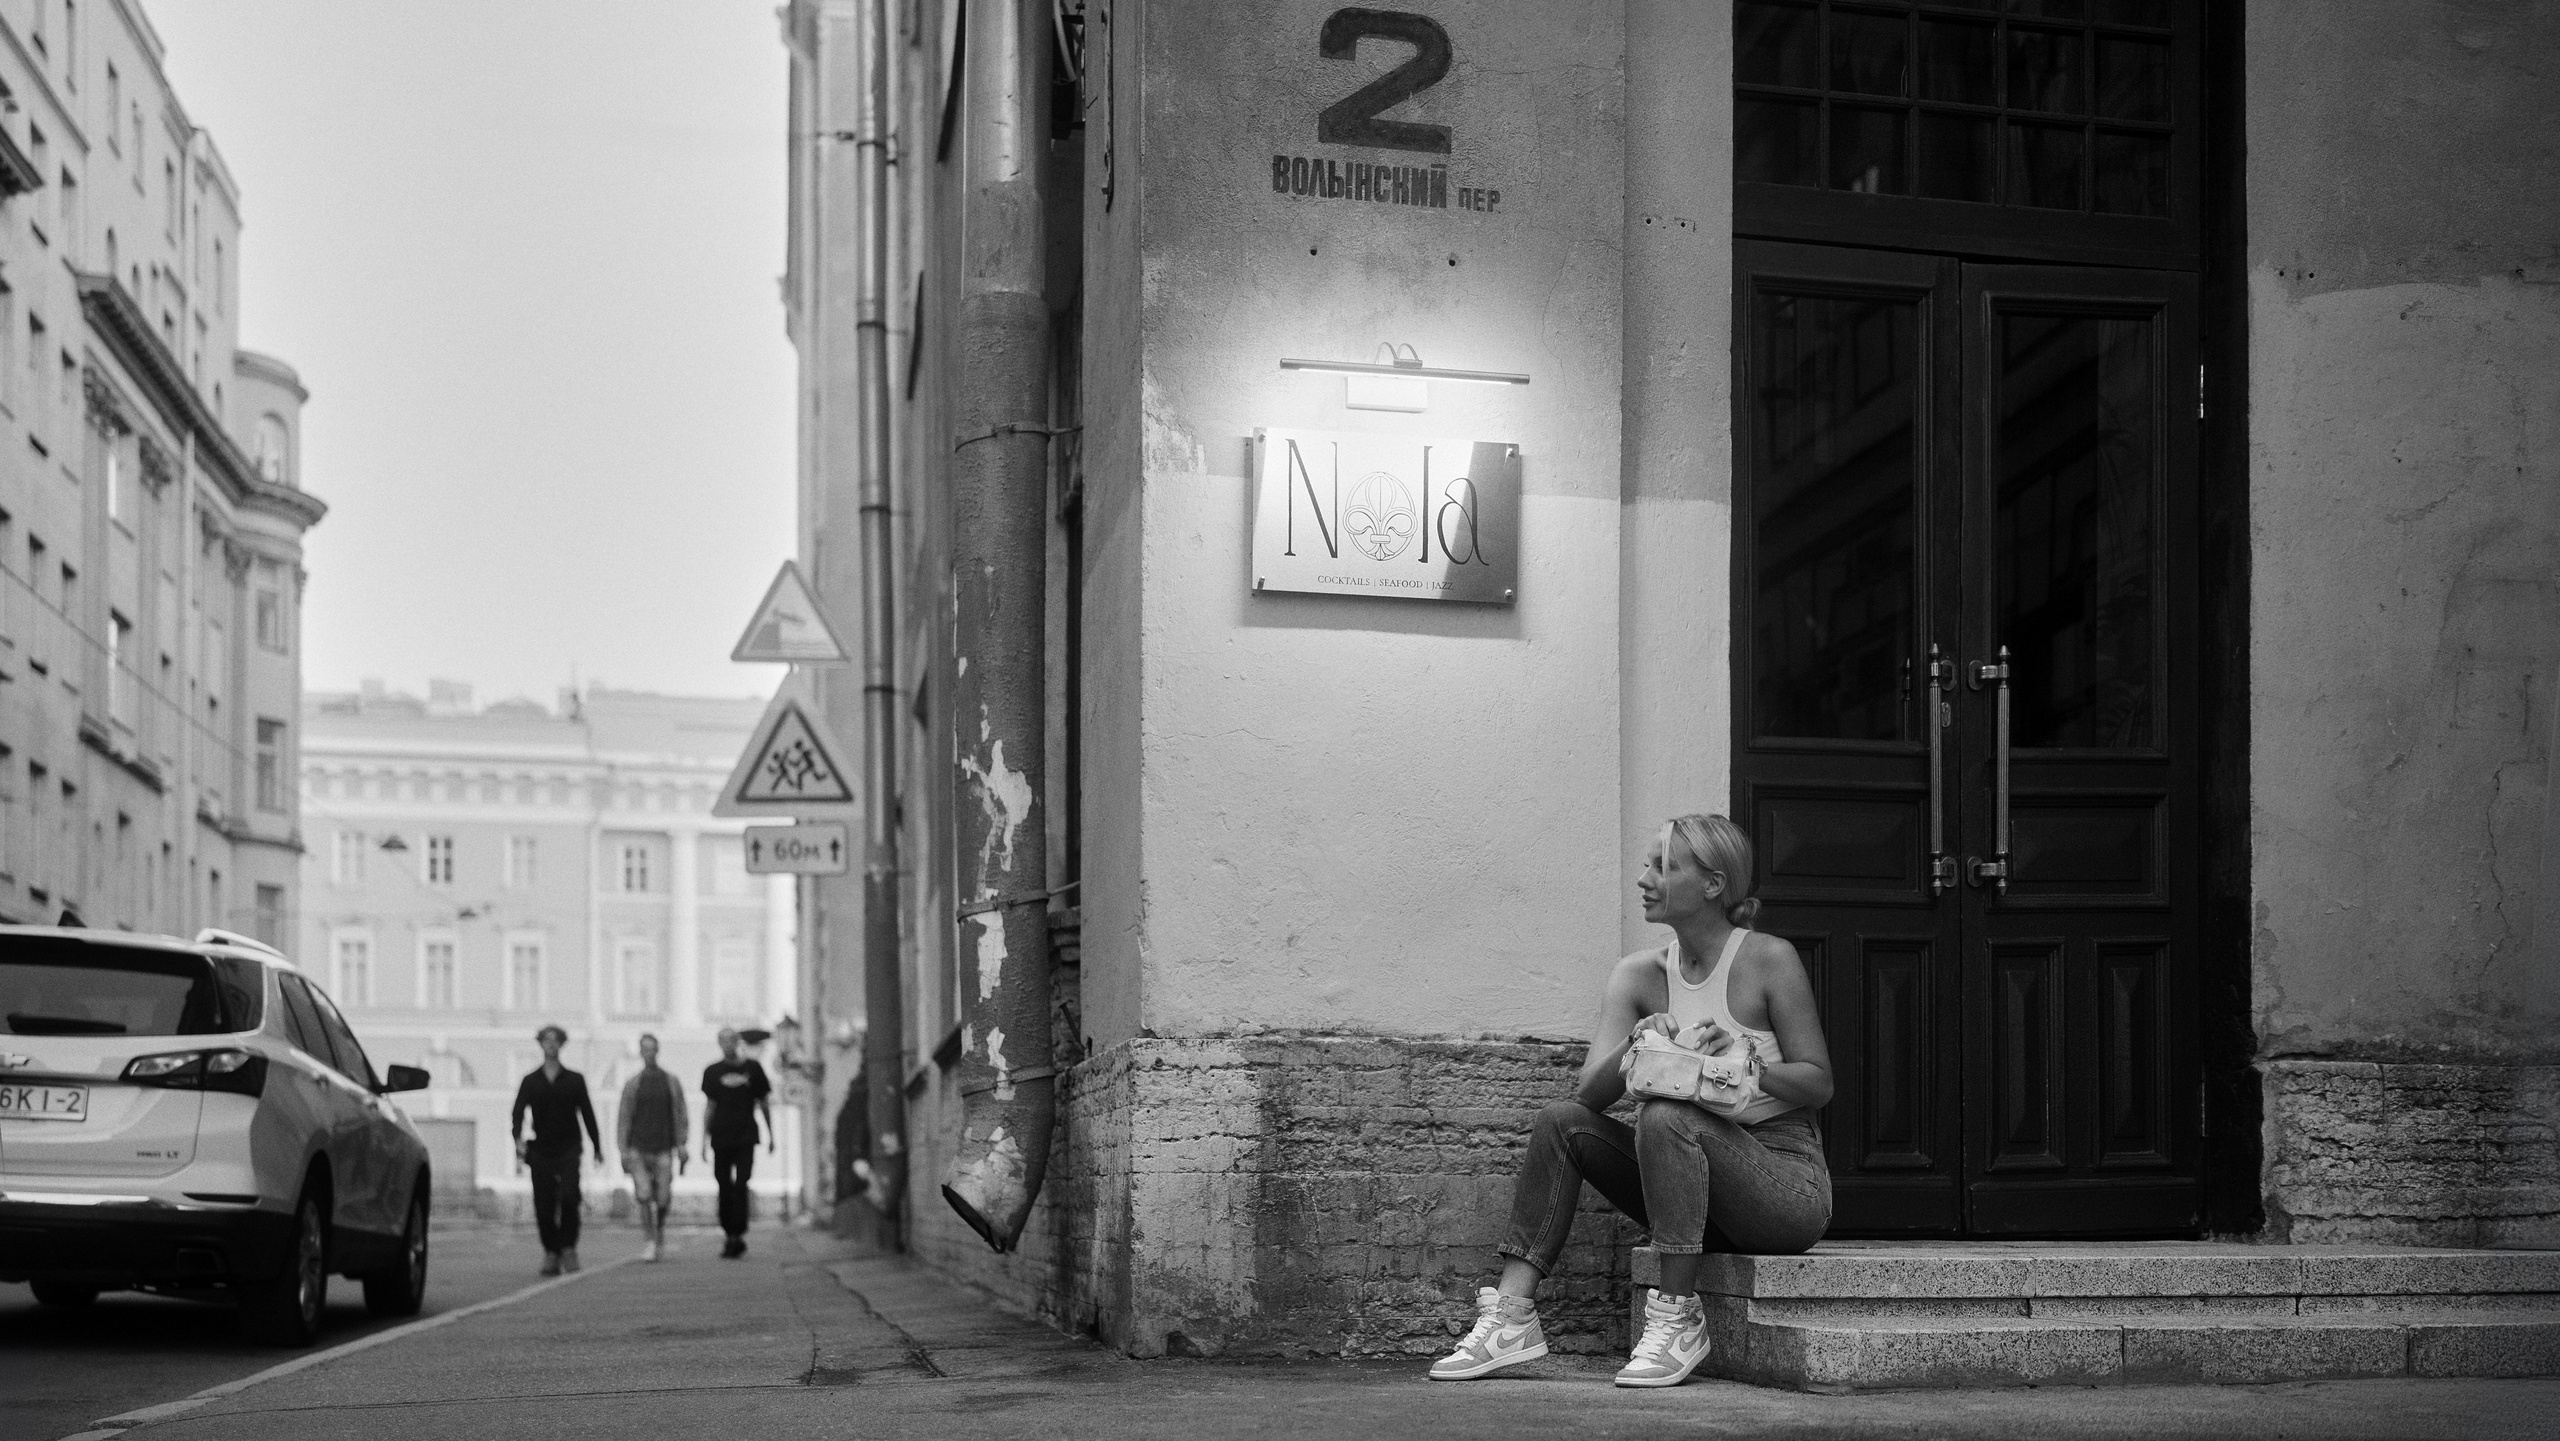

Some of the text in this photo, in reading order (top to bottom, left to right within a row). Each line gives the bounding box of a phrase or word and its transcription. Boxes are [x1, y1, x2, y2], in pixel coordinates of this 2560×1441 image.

[1318, 7, 1452, 154] 2
[1272, 154, 1447, 209] ВОЛЫНСКИЙ
[1317, 575, 1454, 591] COCKTAILS SEAFOOD JAZZ
